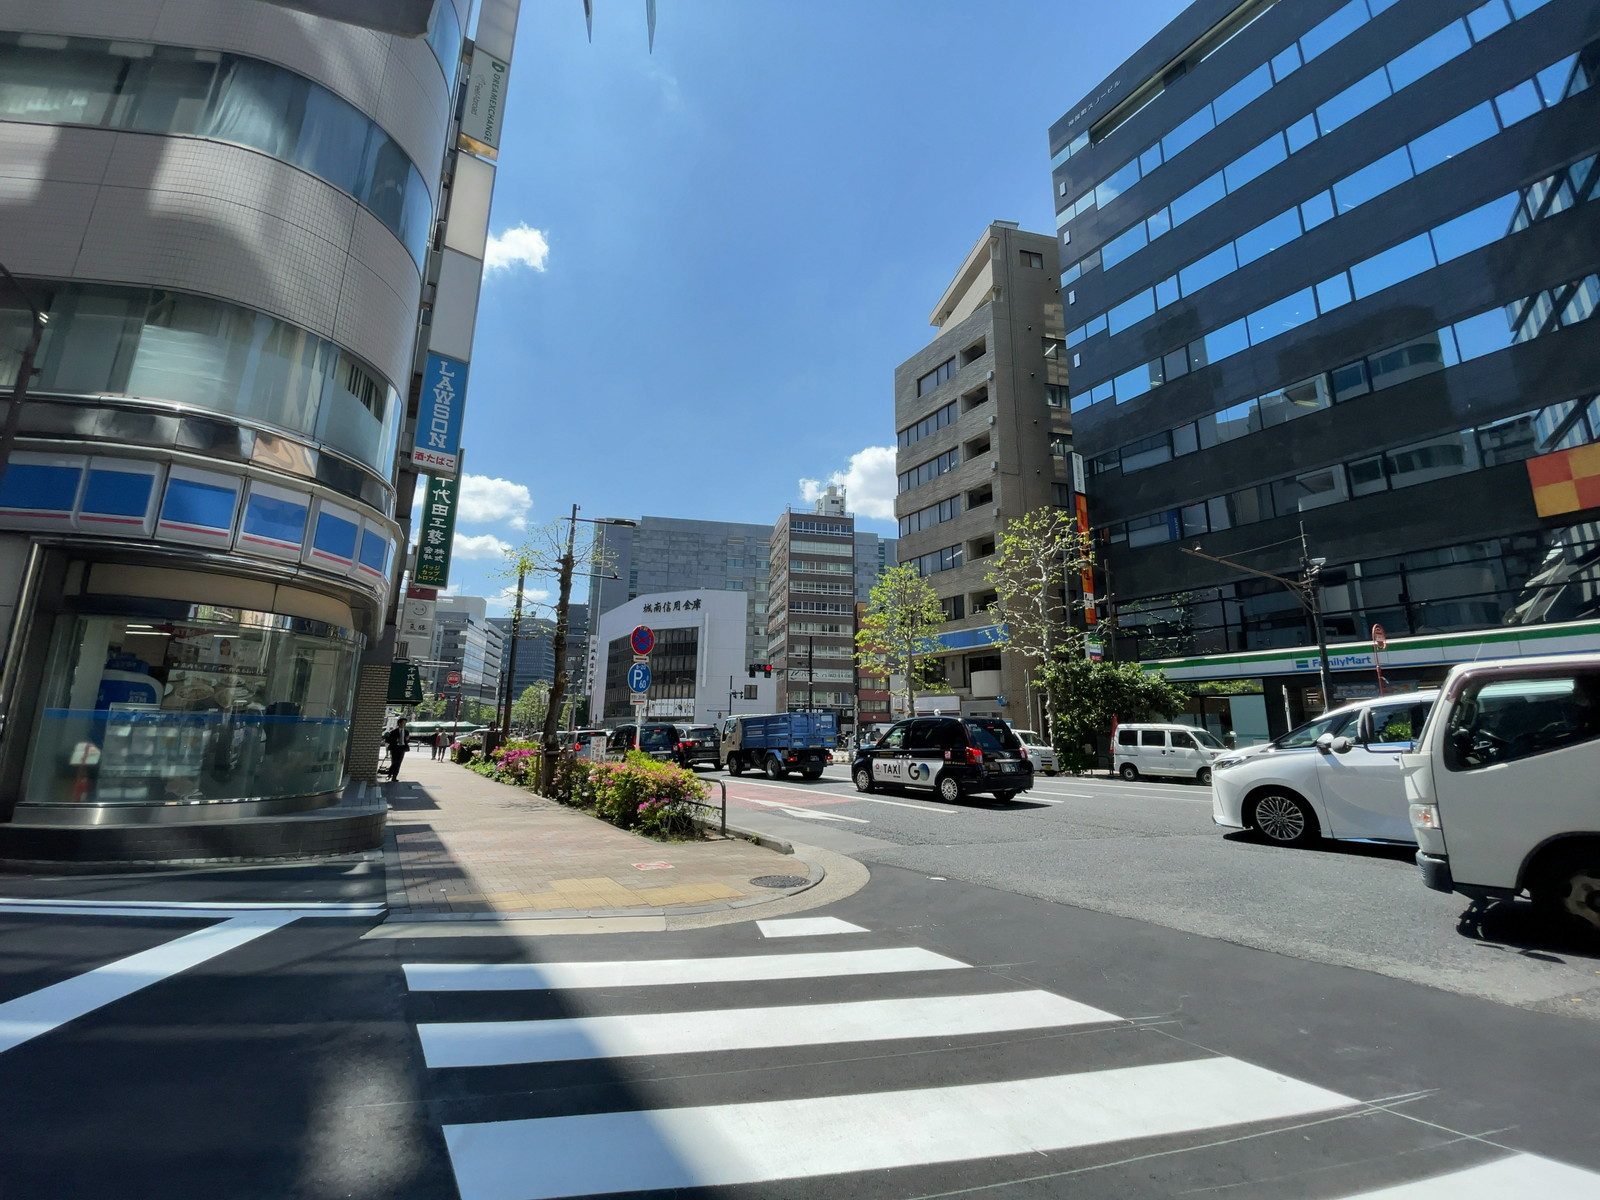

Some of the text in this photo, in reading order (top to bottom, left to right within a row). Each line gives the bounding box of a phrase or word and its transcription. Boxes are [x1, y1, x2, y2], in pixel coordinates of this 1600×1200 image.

[483, 73, 501, 143] DREAMEXCHANGE
[428, 360, 456, 449] LAWSON
[417, 574, 444, 582] トロフィー
[642, 597, 702, 613] 城南信用金庫
[632, 669, 643, 689] P
[882, 762, 930, 781] TAXI GO
